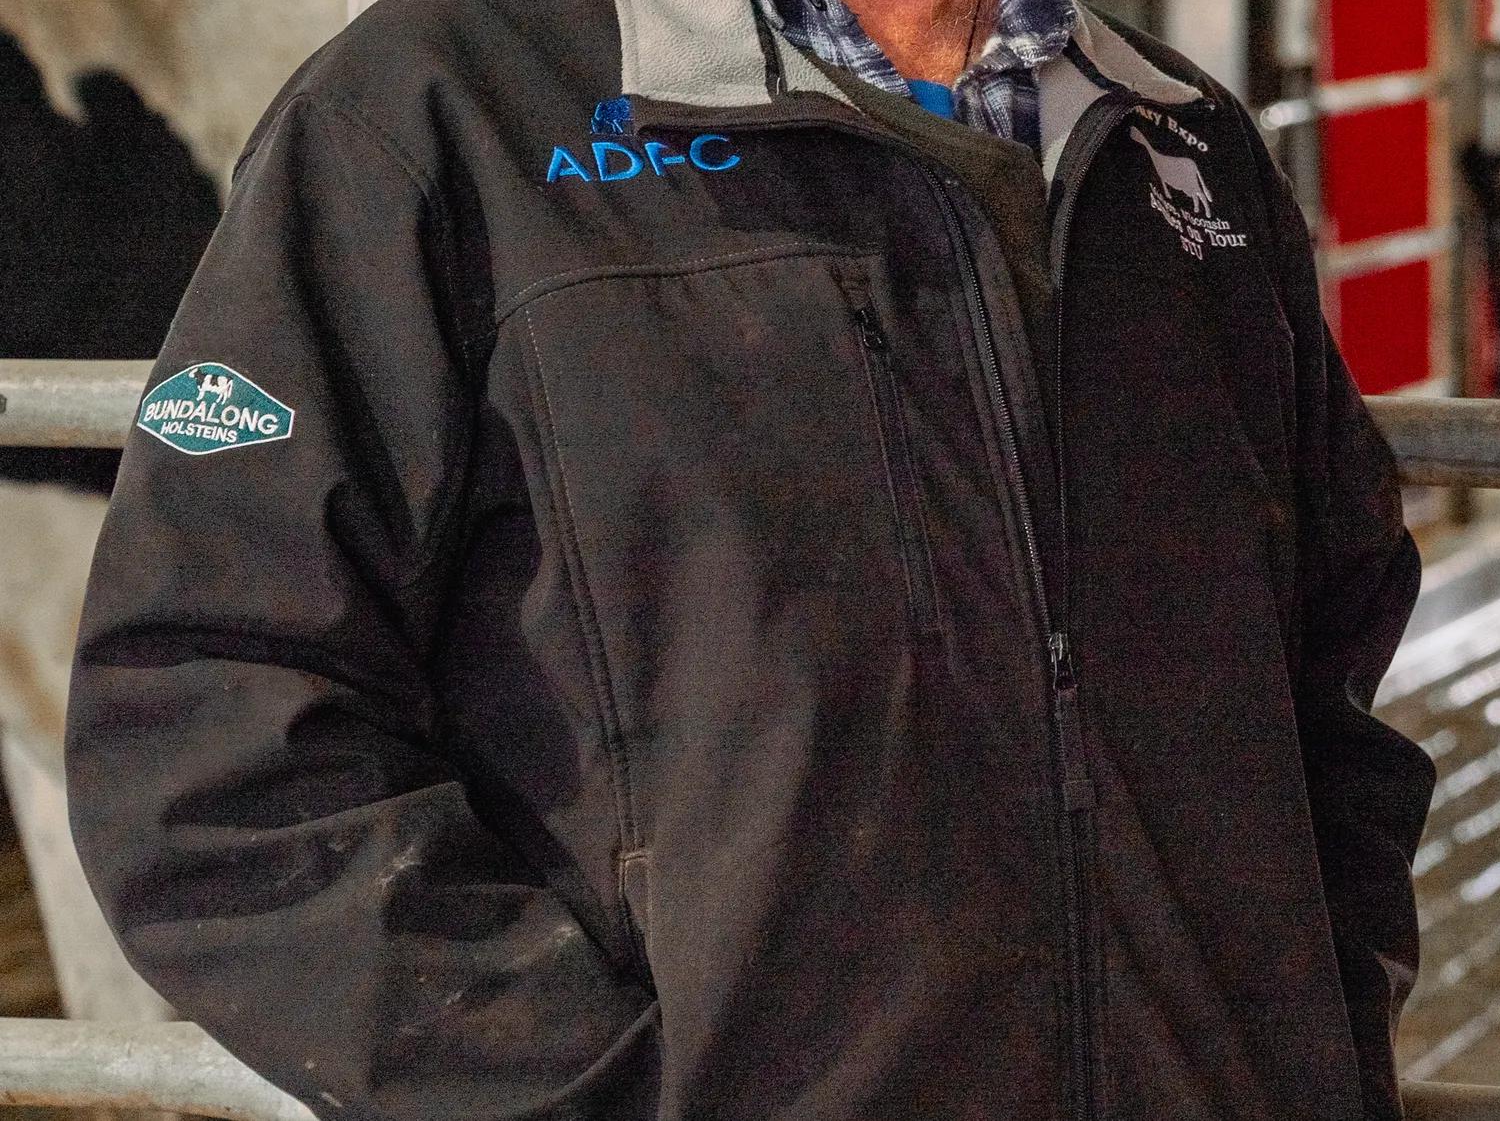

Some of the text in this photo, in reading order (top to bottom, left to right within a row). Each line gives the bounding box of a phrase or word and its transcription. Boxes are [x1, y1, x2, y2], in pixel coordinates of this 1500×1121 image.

[547, 134, 741, 183] ADFC
[1205, 228, 1247, 247] Tour
[143, 399, 279, 434] BUNDALONG
[160, 421, 238, 443] HOLSTEINS
